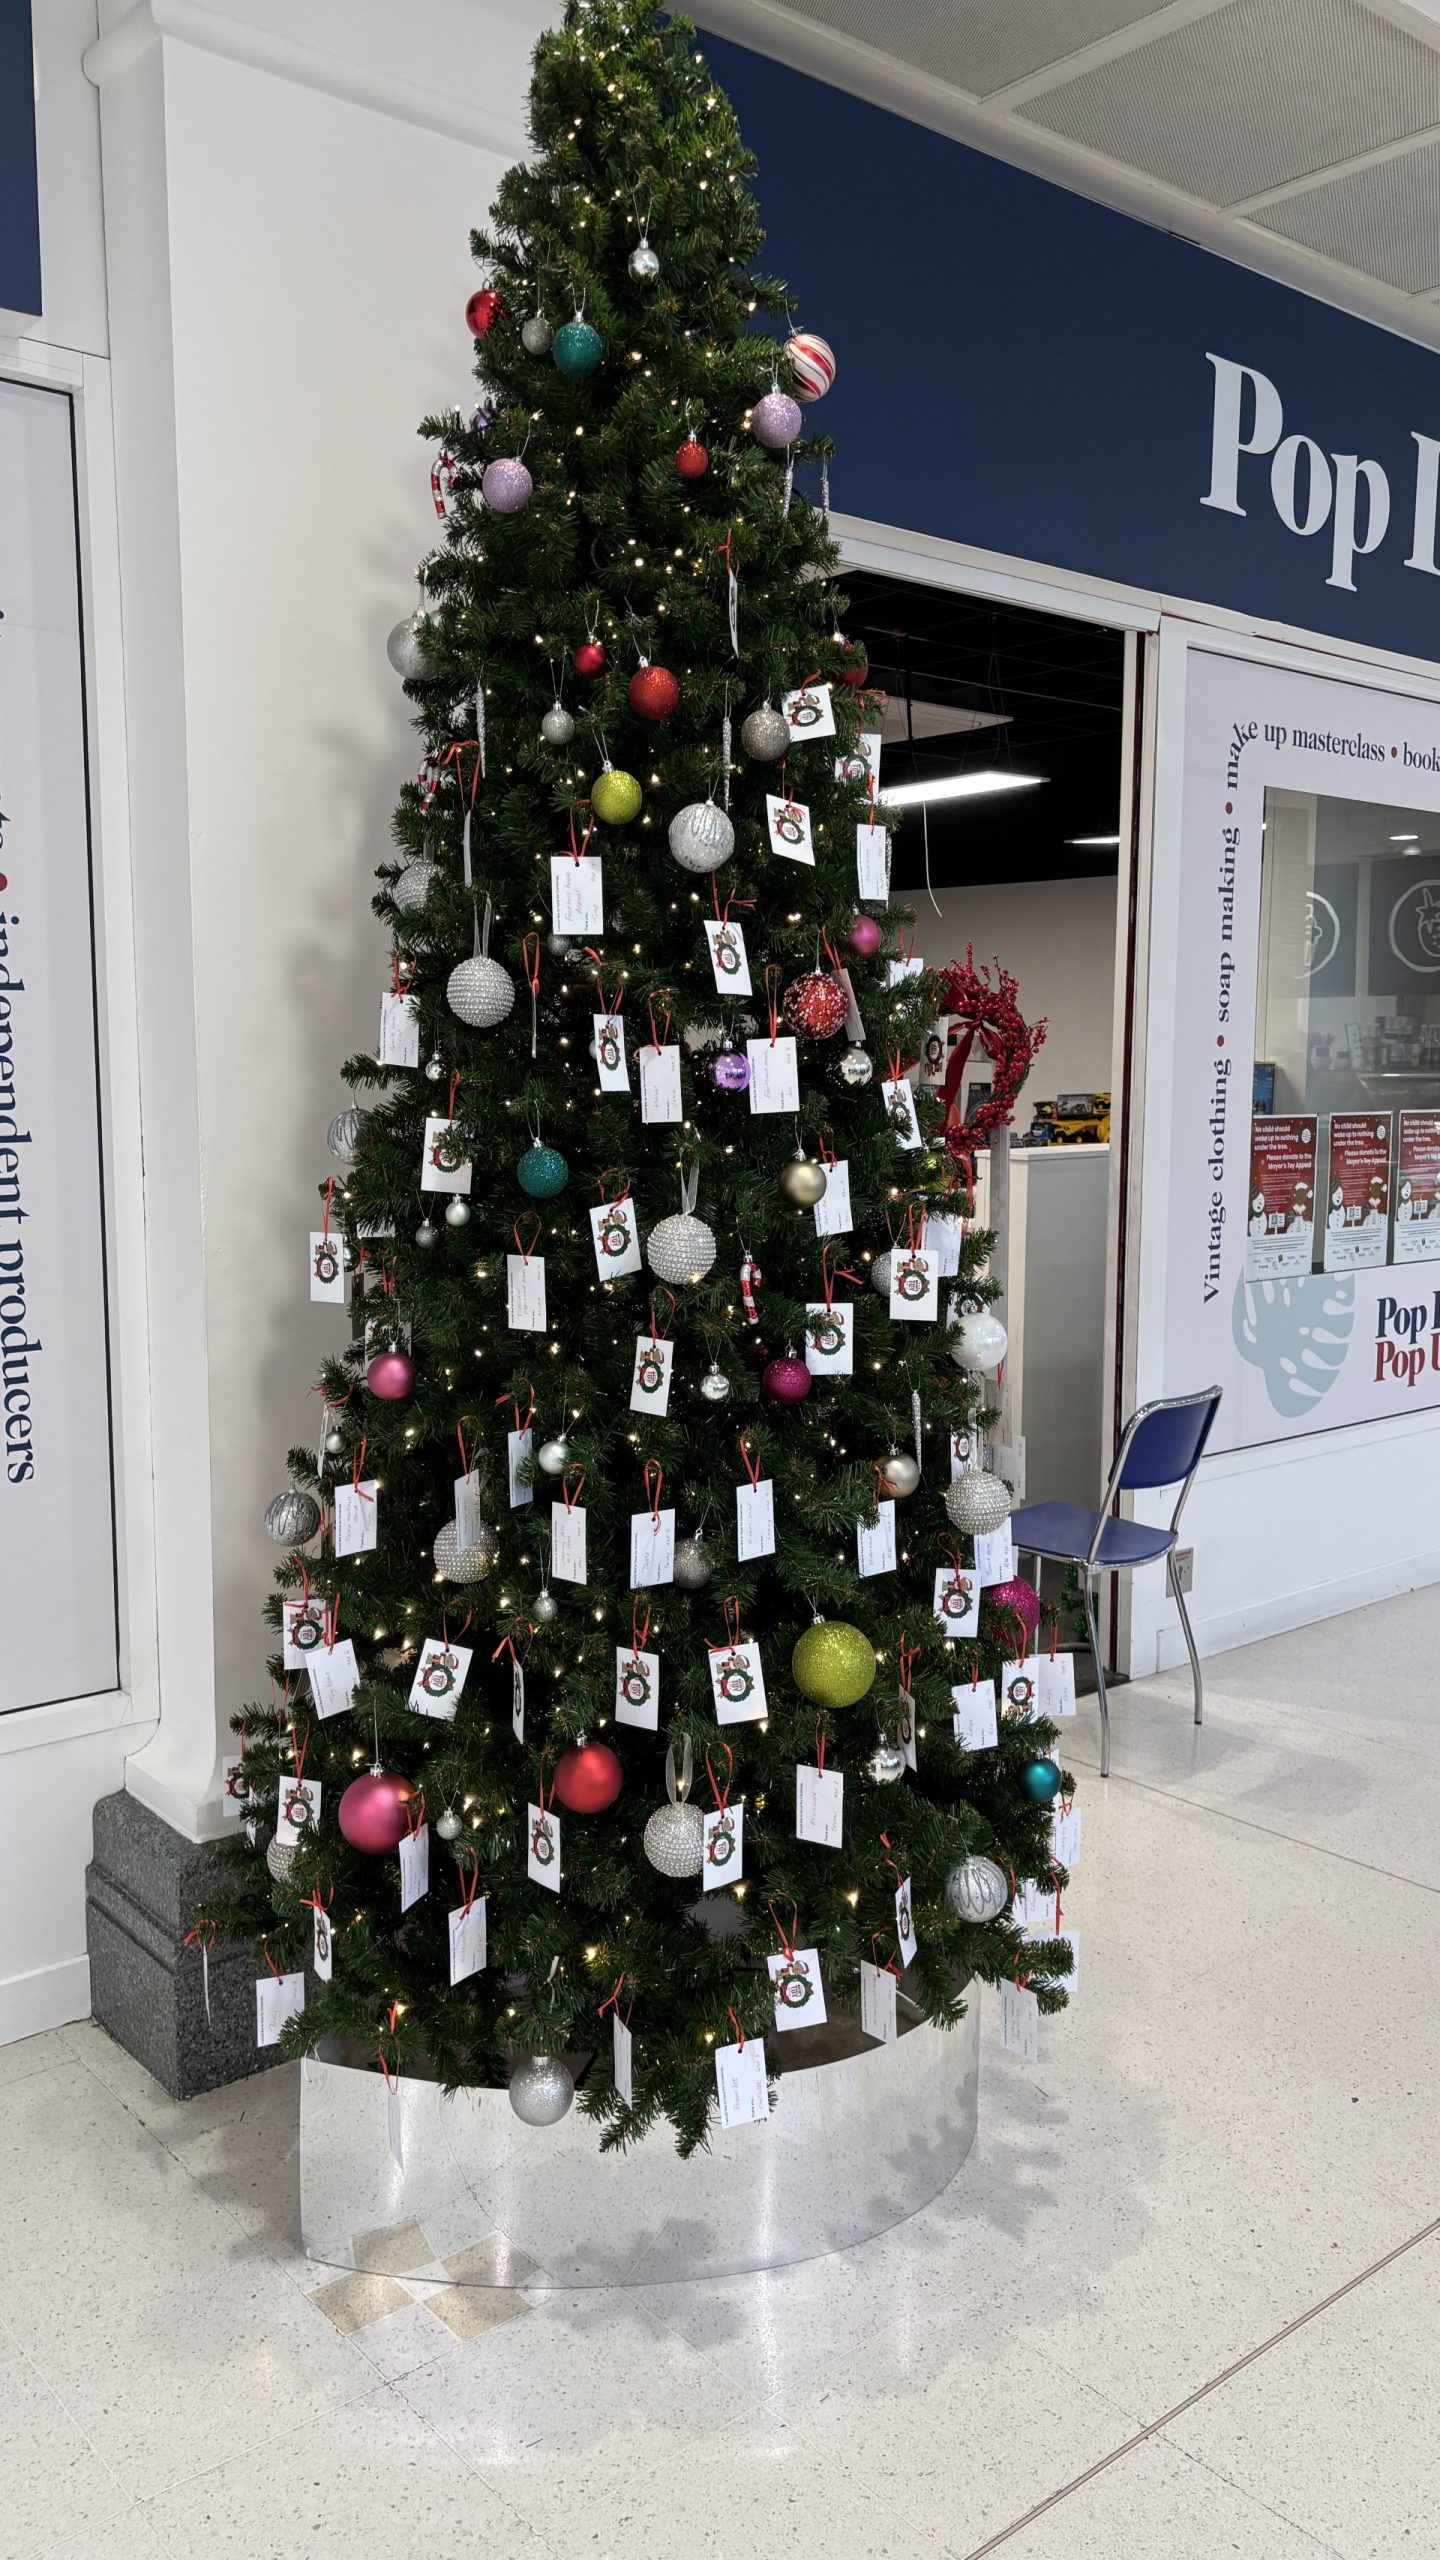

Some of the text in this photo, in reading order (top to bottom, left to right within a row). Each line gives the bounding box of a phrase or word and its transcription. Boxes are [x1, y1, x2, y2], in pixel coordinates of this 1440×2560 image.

[1200, 352, 1390, 592] Pop
[1226, 721, 1258, 790] make
[1264, 723, 1287, 750] up
[1292, 728, 1386, 762] masterclass
[1218, 828, 1240, 1023] soap making
[1203, 1058, 1232, 1305] Vintage clothing
[0, 1238, 42, 1484] producers
[1373, 1340, 1425, 1387] Pop
[1375, 1297, 1427, 1345] Pop
